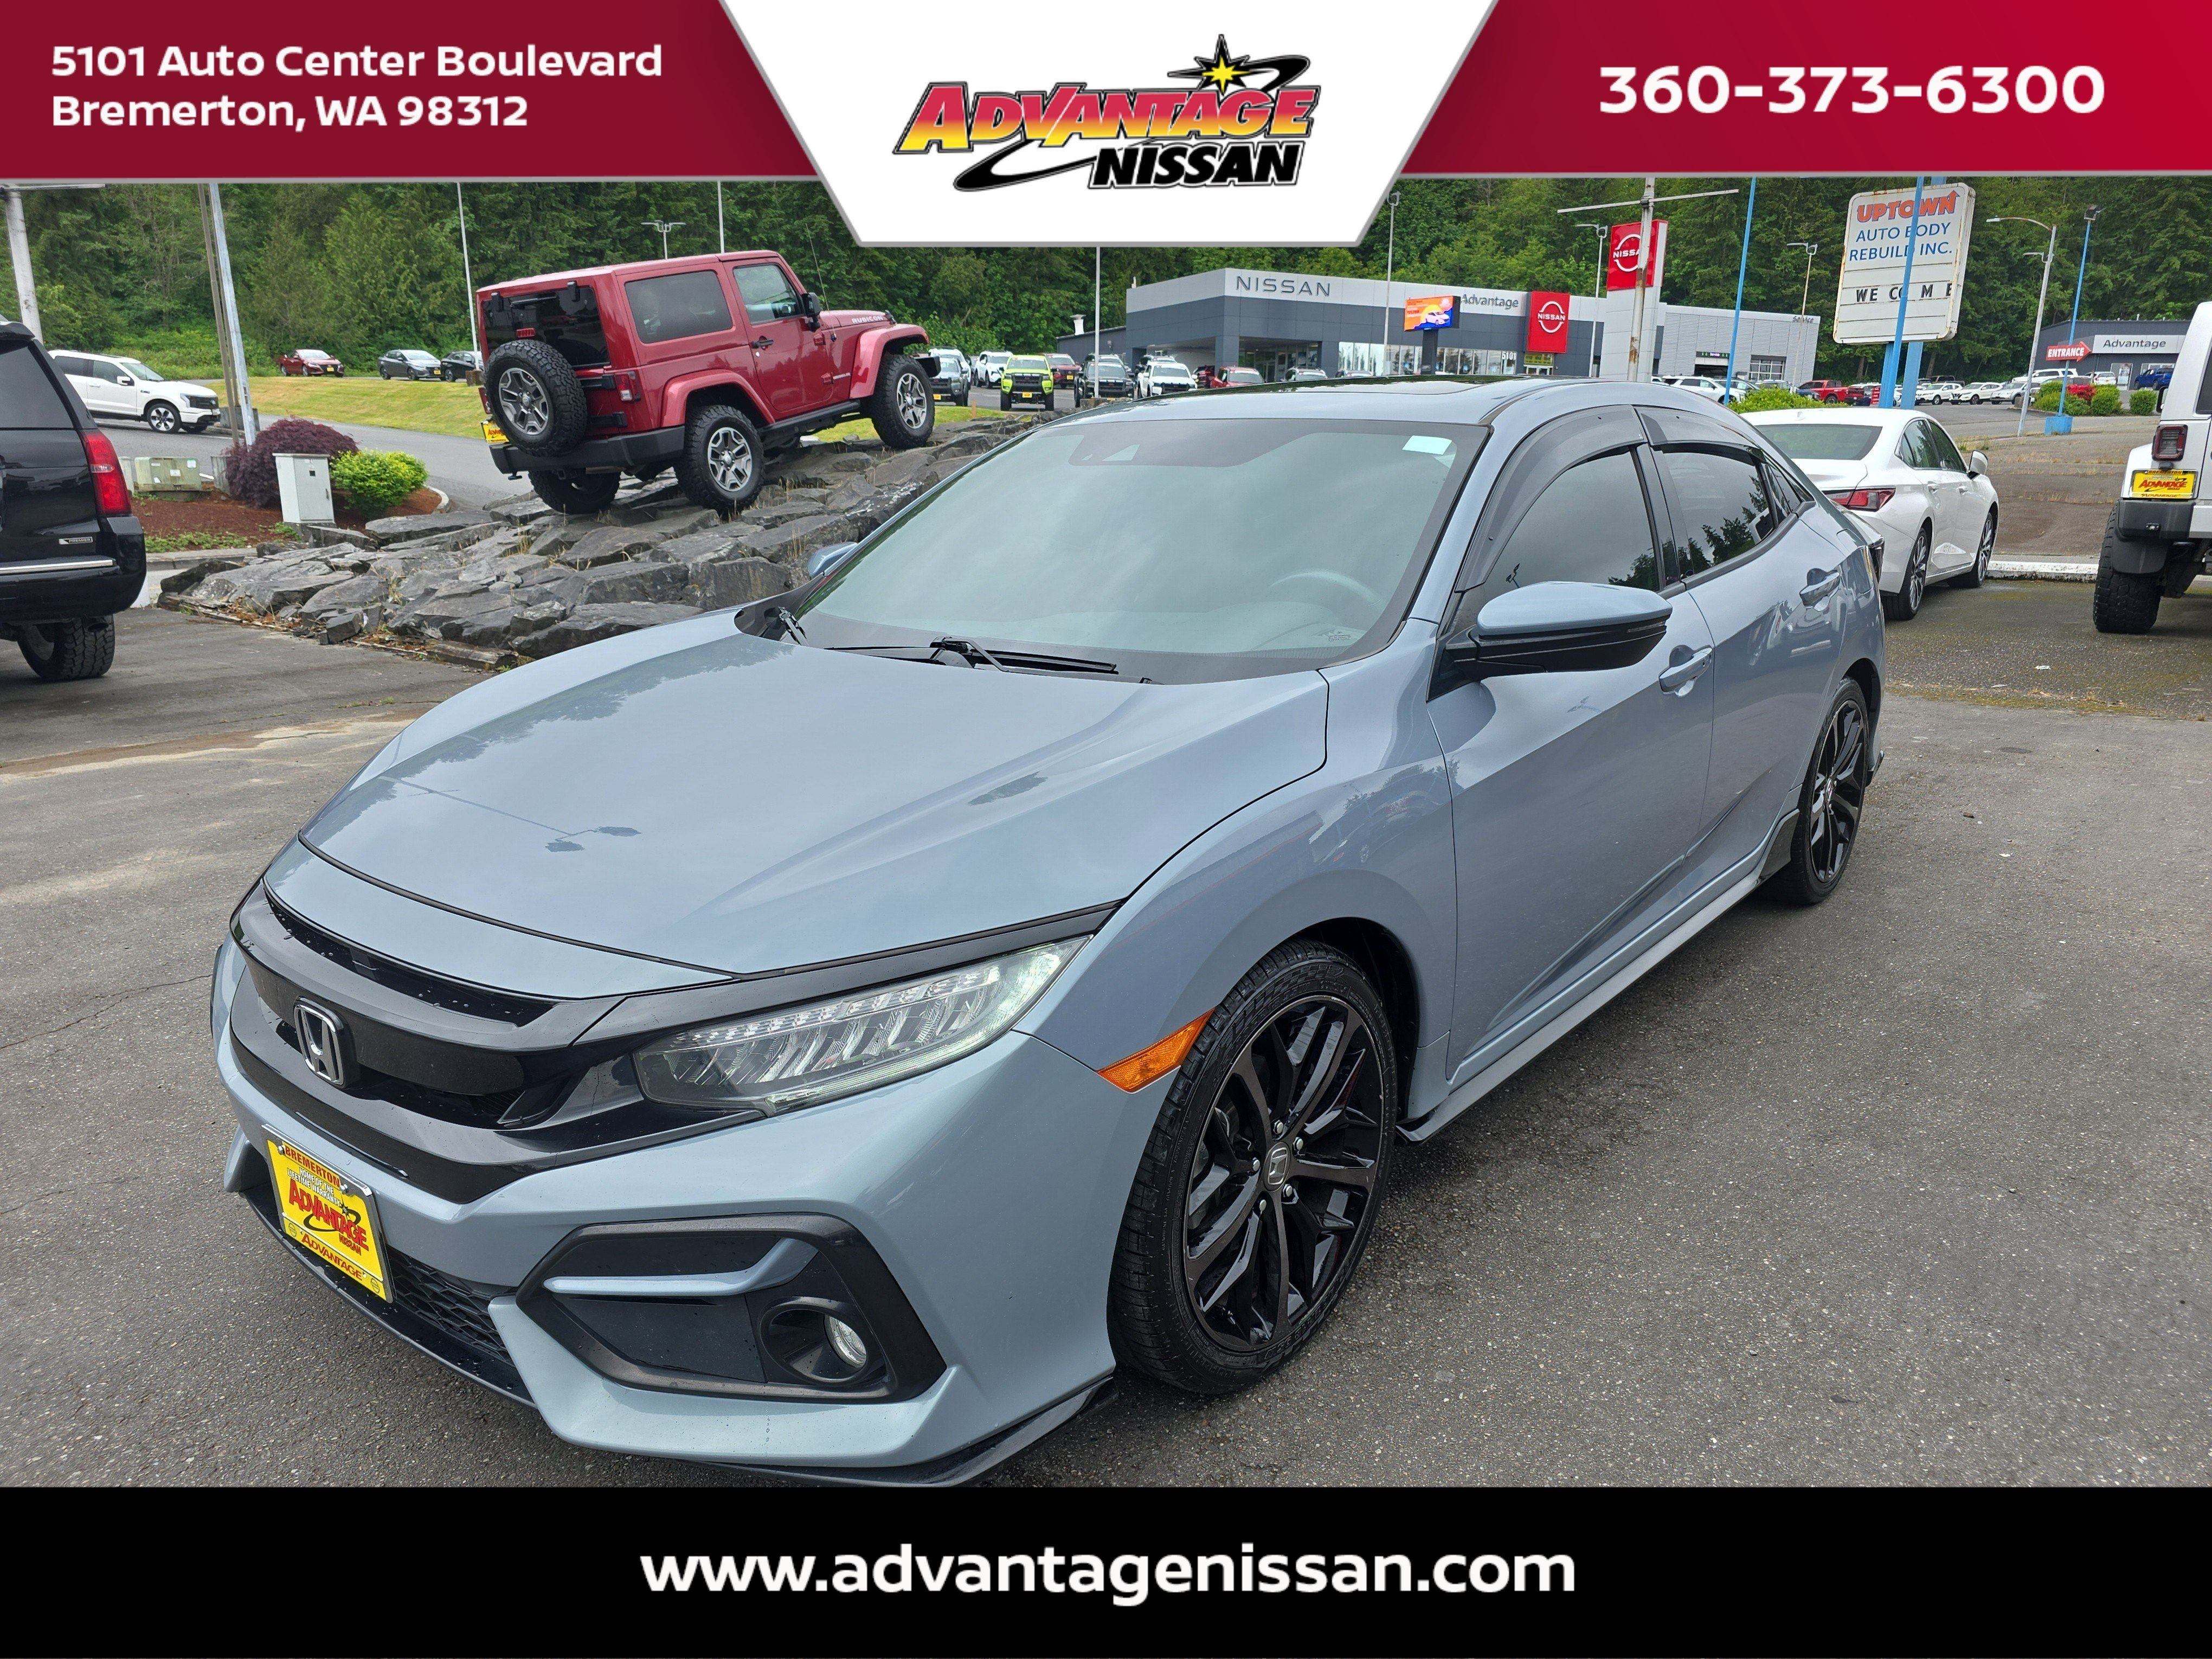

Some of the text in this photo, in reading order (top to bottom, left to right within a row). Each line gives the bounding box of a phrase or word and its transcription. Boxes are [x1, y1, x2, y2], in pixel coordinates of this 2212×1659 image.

[1857, 191, 1959, 222] UPTOWN
[1856, 227, 1900, 242] AUTO
[1613, 249, 1640, 259] NISSA
[1920, 242, 1952, 256] INC.
[1237, 276, 1330, 297] NISSAN
[1461, 294, 1519, 310] Advantage
[851, 316, 884, 324] RUBICON
[1537, 312, 1566, 321] NISSAN
[2103, 339, 2166, 349] Advantage
[2048, 347, 2085, 357] ENTRANCE
[2138, 479, 2188, 488] ADVANTAGE
[285, 1144, 340, 1188] BREMERTON
[287, 1167, 340, 1207] LIFETIME WARRANTY
[299, 1167, 334, 1195] HOME OF THE
[289, 1178, 369, 1252] ADVANTAGE
[301, 1233, 362, 1281] ADVANTAGE
